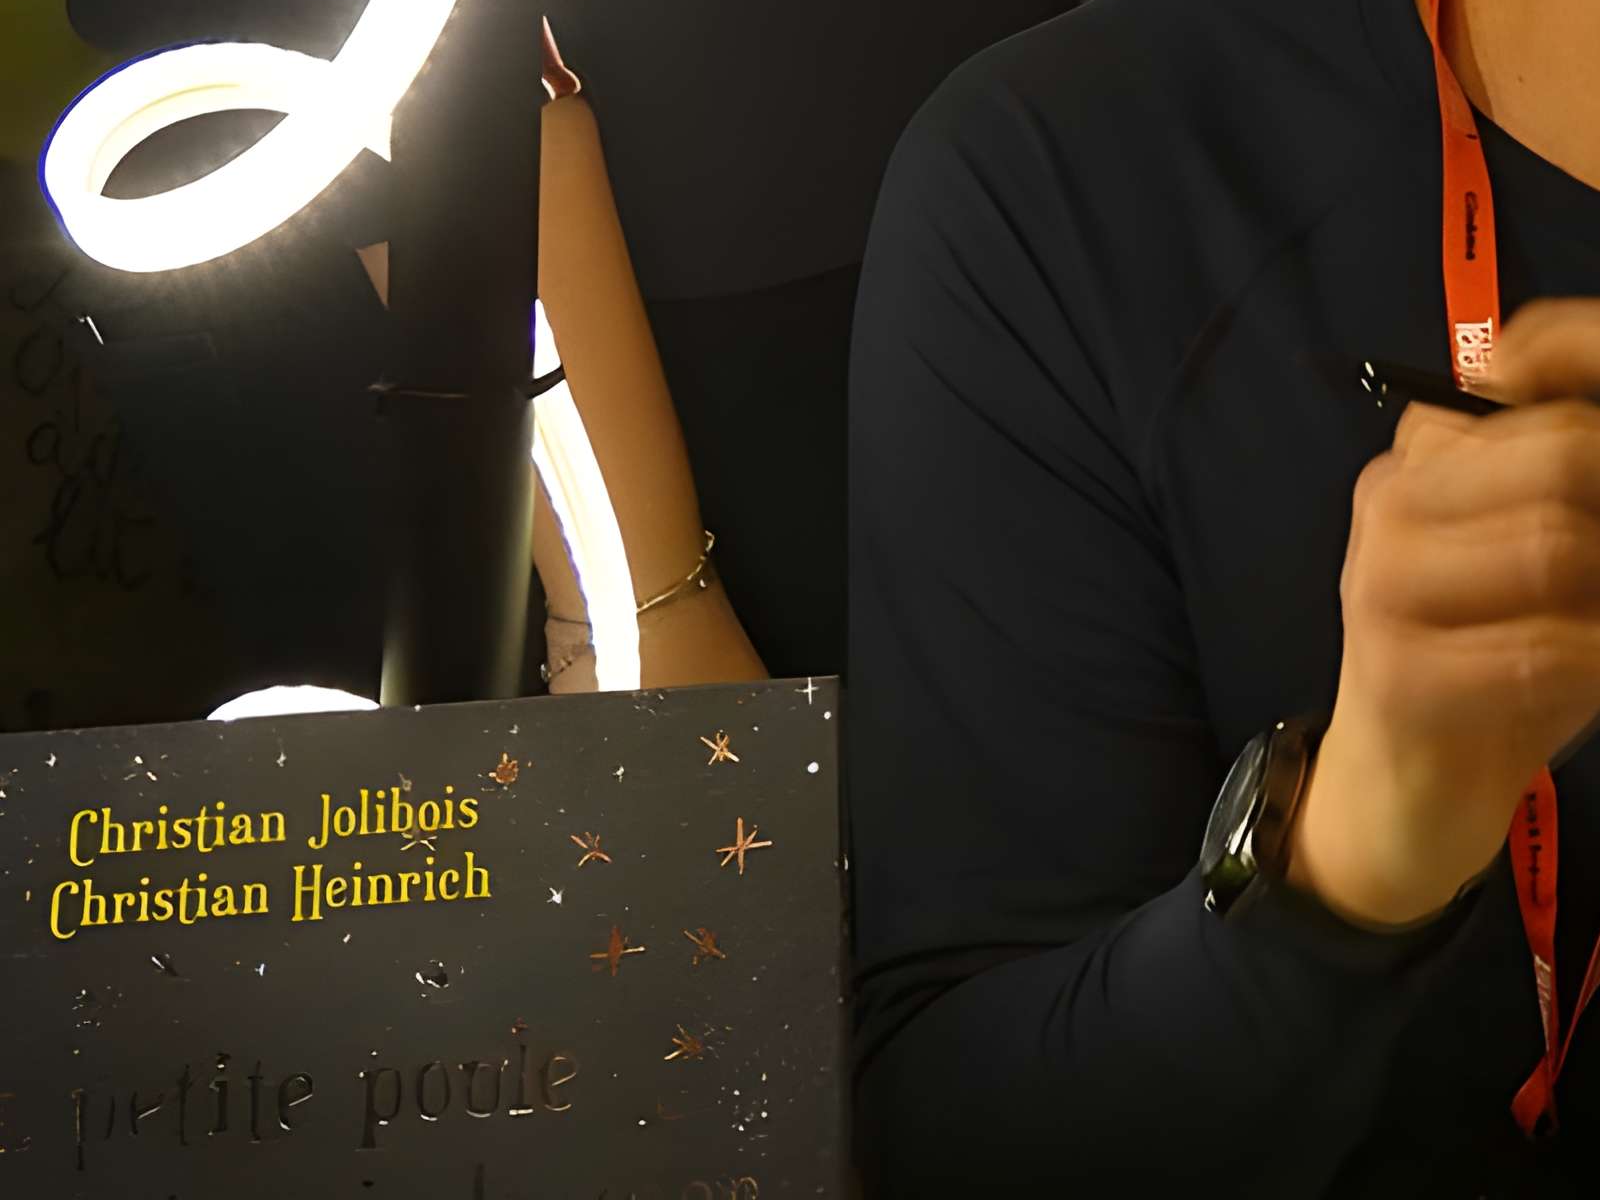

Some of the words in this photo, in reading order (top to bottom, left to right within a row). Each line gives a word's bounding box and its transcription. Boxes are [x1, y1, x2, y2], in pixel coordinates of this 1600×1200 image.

[69, 800, 287, 867] Christian
[307, 785, 480, 850] Jolibois
[49, 872, 269, 940] Christian
[291, 851, 492, 922] Heinrich
